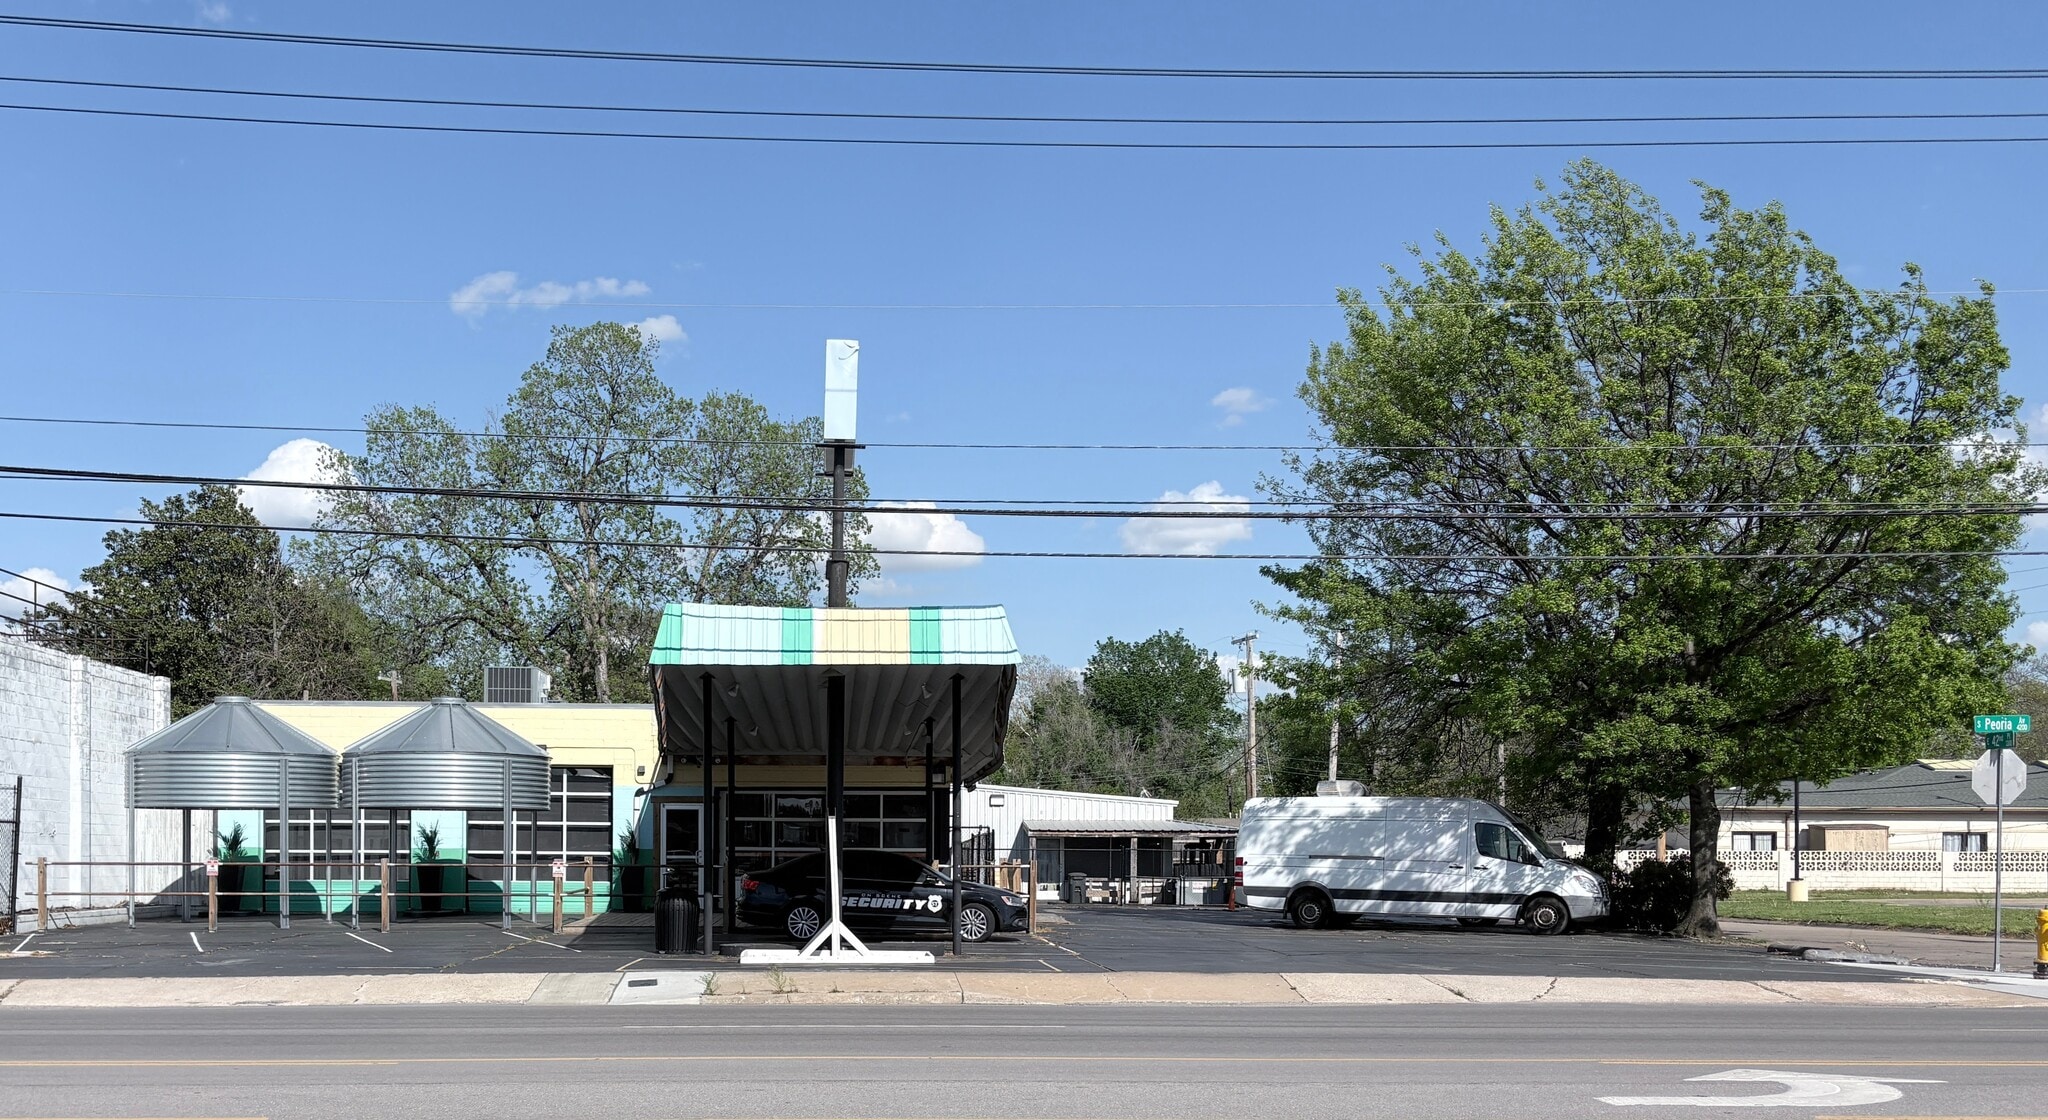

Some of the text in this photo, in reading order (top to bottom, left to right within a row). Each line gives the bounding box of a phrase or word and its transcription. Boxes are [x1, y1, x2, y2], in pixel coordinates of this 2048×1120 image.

[1977, 720, 1981, 728] S
[1985, 717, 2012, 730] Peoria
[841, 896, 928, 910] SECURITY
